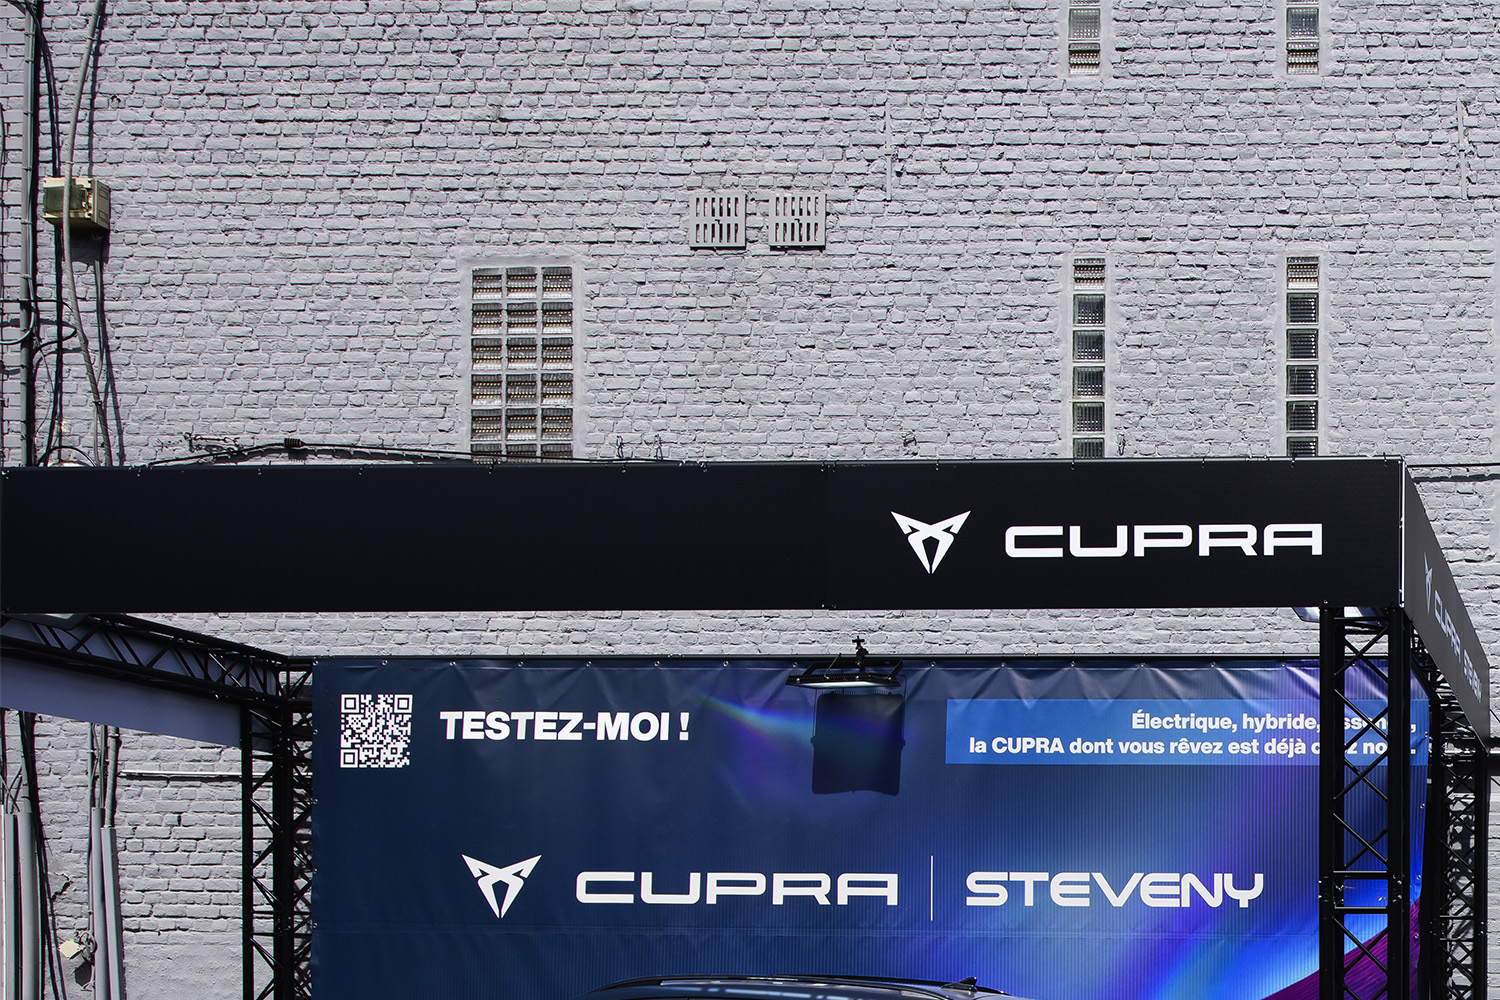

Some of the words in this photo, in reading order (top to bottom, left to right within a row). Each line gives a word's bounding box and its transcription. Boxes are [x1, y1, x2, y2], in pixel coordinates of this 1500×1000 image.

[1004, 523, 1323, 558] CUPRA
[439, 711, 669, 741] TESTEZ-MOI
[1132, 709, 1238, 734] Électrique,
[969, 737, 987, 754] la
[991, 737, 1065, 754] CUPRA
[1069, 737, 1114, 755] dont
[1118, 741, 1165, 755] vous
[1169, 738, 1223, 755] rêvez
[1227, 739, 1259, 755] est
[1264, 738, 1306, 759] déjà
[575, 872, 899, 906] CUPRA
[965, 872, 1264, 908] STEVENY
